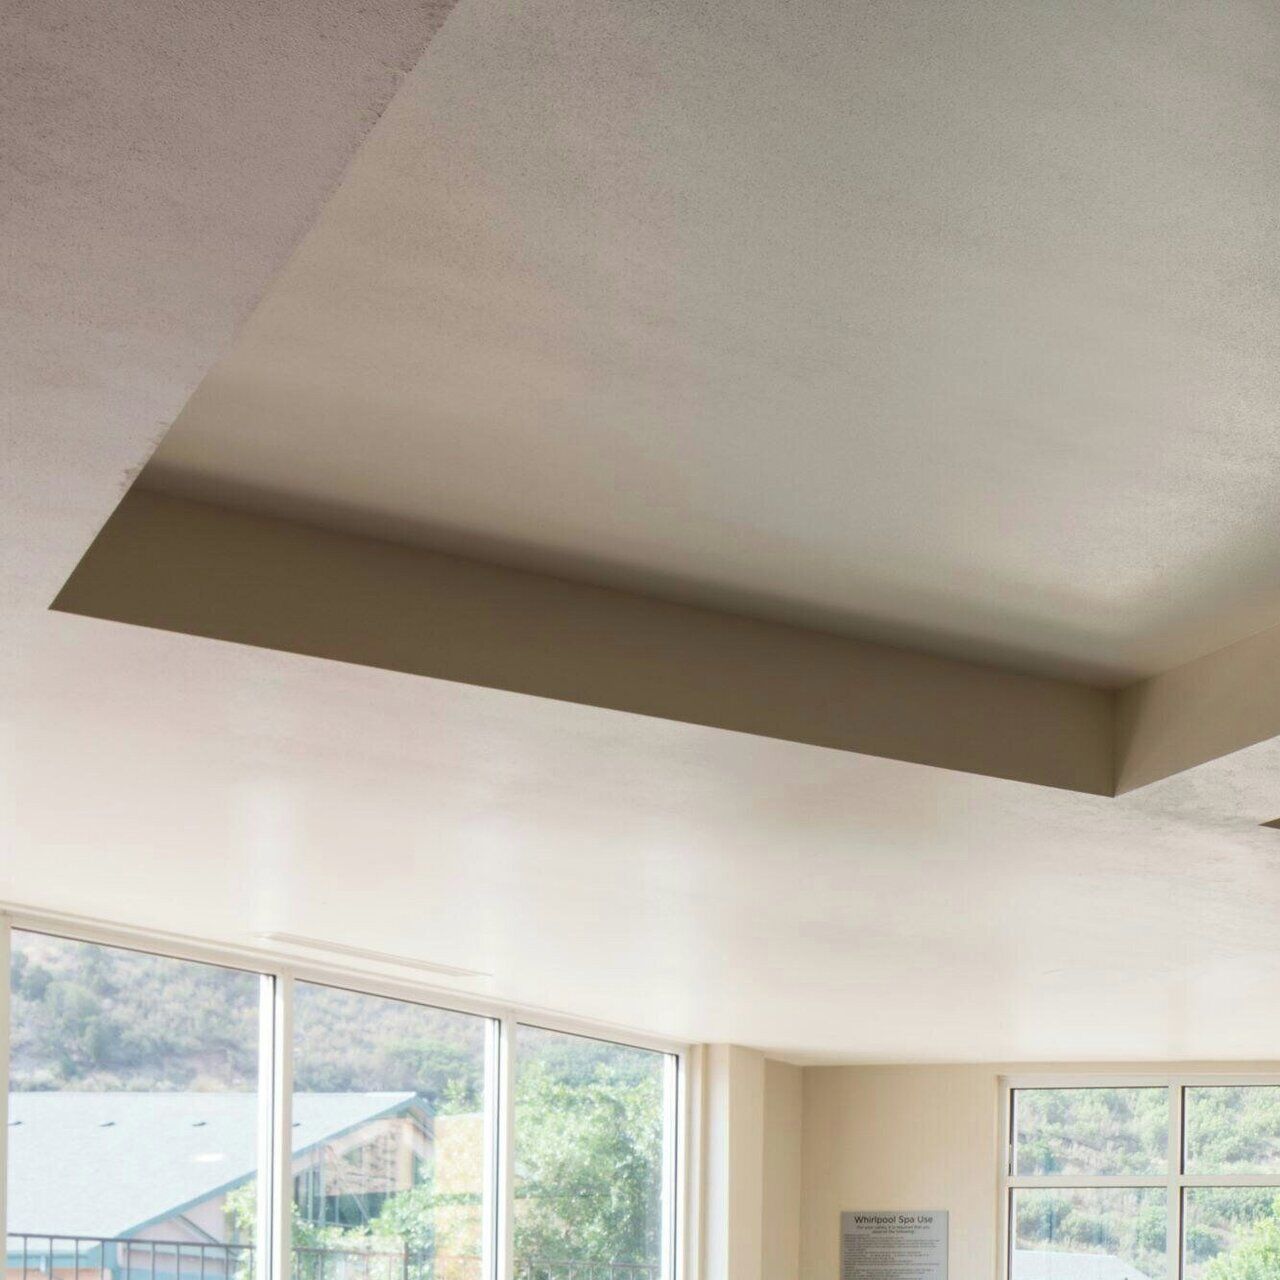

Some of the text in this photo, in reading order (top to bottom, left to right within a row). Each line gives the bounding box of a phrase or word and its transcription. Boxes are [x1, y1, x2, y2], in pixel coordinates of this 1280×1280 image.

[854, 1215, 933, 1224] Whirlpool Spa Use
